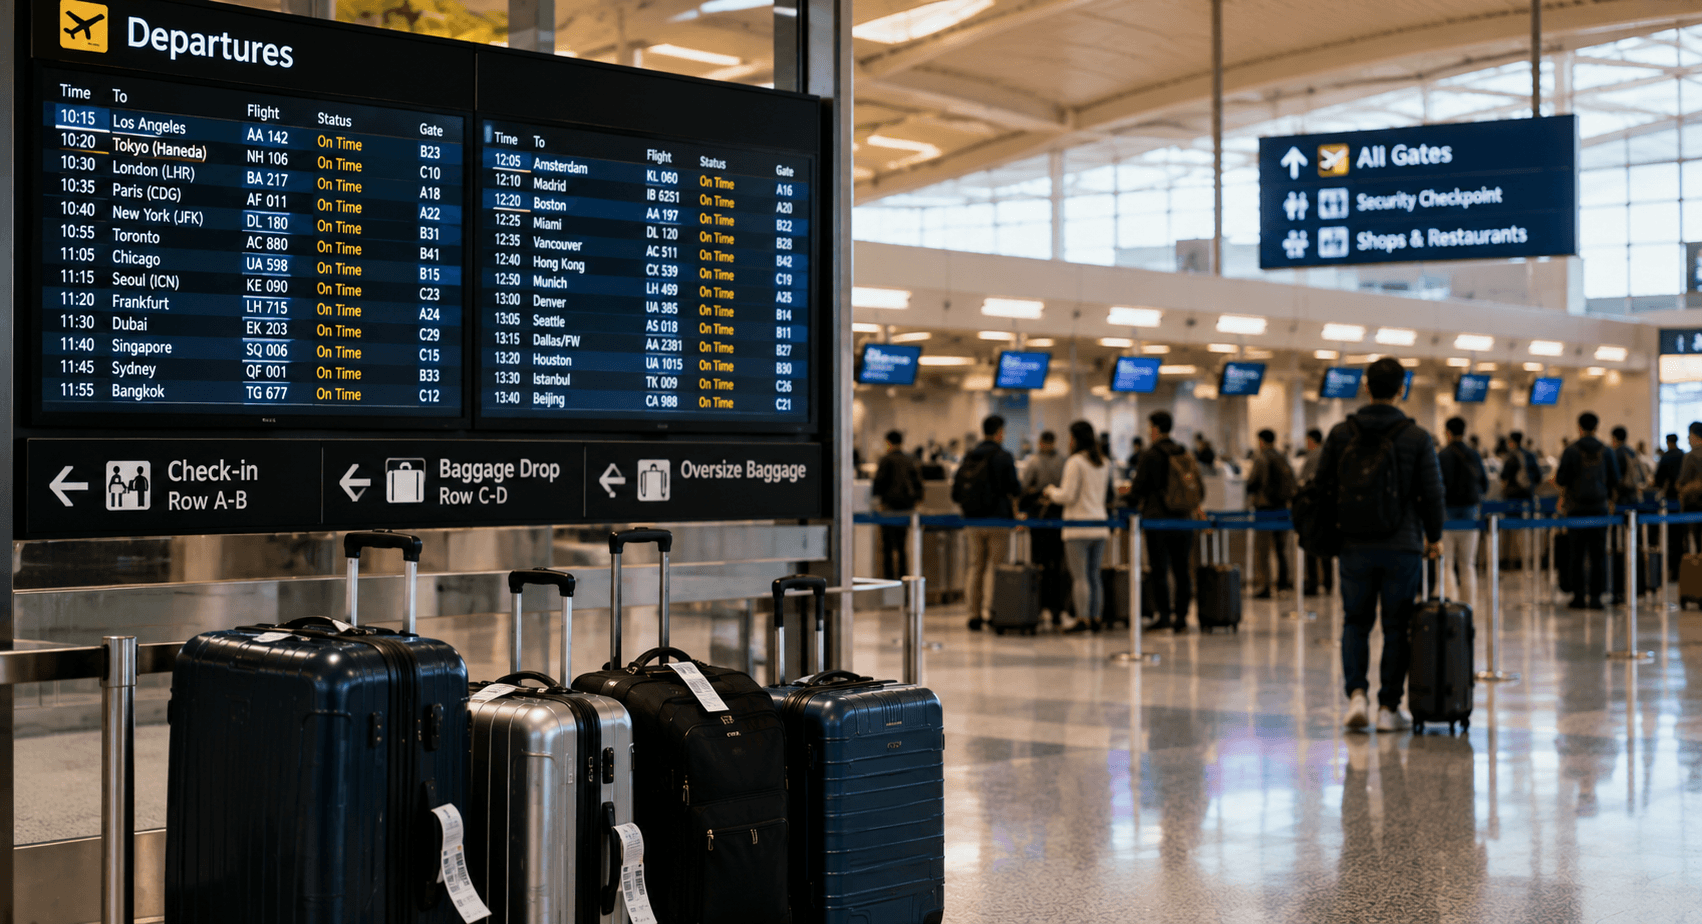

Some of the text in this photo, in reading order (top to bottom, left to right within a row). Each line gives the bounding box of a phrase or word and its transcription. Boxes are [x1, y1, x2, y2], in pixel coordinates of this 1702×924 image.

[127, 16, 294, 69] Departures
[60, 84, 443, 136] Time To Flight Status Gate
[61, 109, 440, 159] 10:15 Los Angeles AA 142 On Time B23
[61, 132, 440, 180] 10:20 Tokyo (Haneda) NH 106 On Time C10
[495, 132, 794, 177] Time To Flight Status Gate
[1356, 144, 1452, 169] All Gates
[61, 155, 440, 200] 10:30 London (LHR) BA 217 On Time A18
[495, 153, 793, 196] 12:05 Amsterdam KL 060 On Time A16
[61, 178, 440, 220] 10:35 Paris (CDG) AF 011 On Time A22
[495, 193, 792, 232] 12:20 Boston AA 197 On Time B22
[1356, 186, 1503, 212] Security Checkpoint
[61, 201, 439, 240] 10:40 New York (JFK) DL 180 On Time B31
[495, 233, 792, 267] 12:35 Vancouver AC 511 On Time B42
[1356, 225, 1528, 253] Shops & Restaurants
[61, 247, 440, 281] 11:05 Chicago UA 598 On Time B15
[495, 253, 792, 285] 12:40 Hong Kong CX 539 On Time C19
[61, 269, 440, 301] 11:15 Seoul (ICN) KE 090 On Time C23
[61, 292, 440, 321] 11:20 Frankfurt LH 715 On Time A24
[495, 312, 791, 338] 13:05 Seattle AS 018 On Time B11
[61, 337, 439, 361] 11:40 Singapore SQ 006 On Time C15
[61, 383, 439, 402] 11:55 Bangkok TG 677 On Time C12
[495, 391, 791, 410] 13:40 Beijing CA 988 On Time C21
[168, 459, 257, 481] Check-in
[440, 459, 559, 483] Baggage Drop
[681, 460, 806, 482] Oversize Baggage
[169, 491, 247, 510] Row A-B
[440, 487, 507, 504] Row C-D
